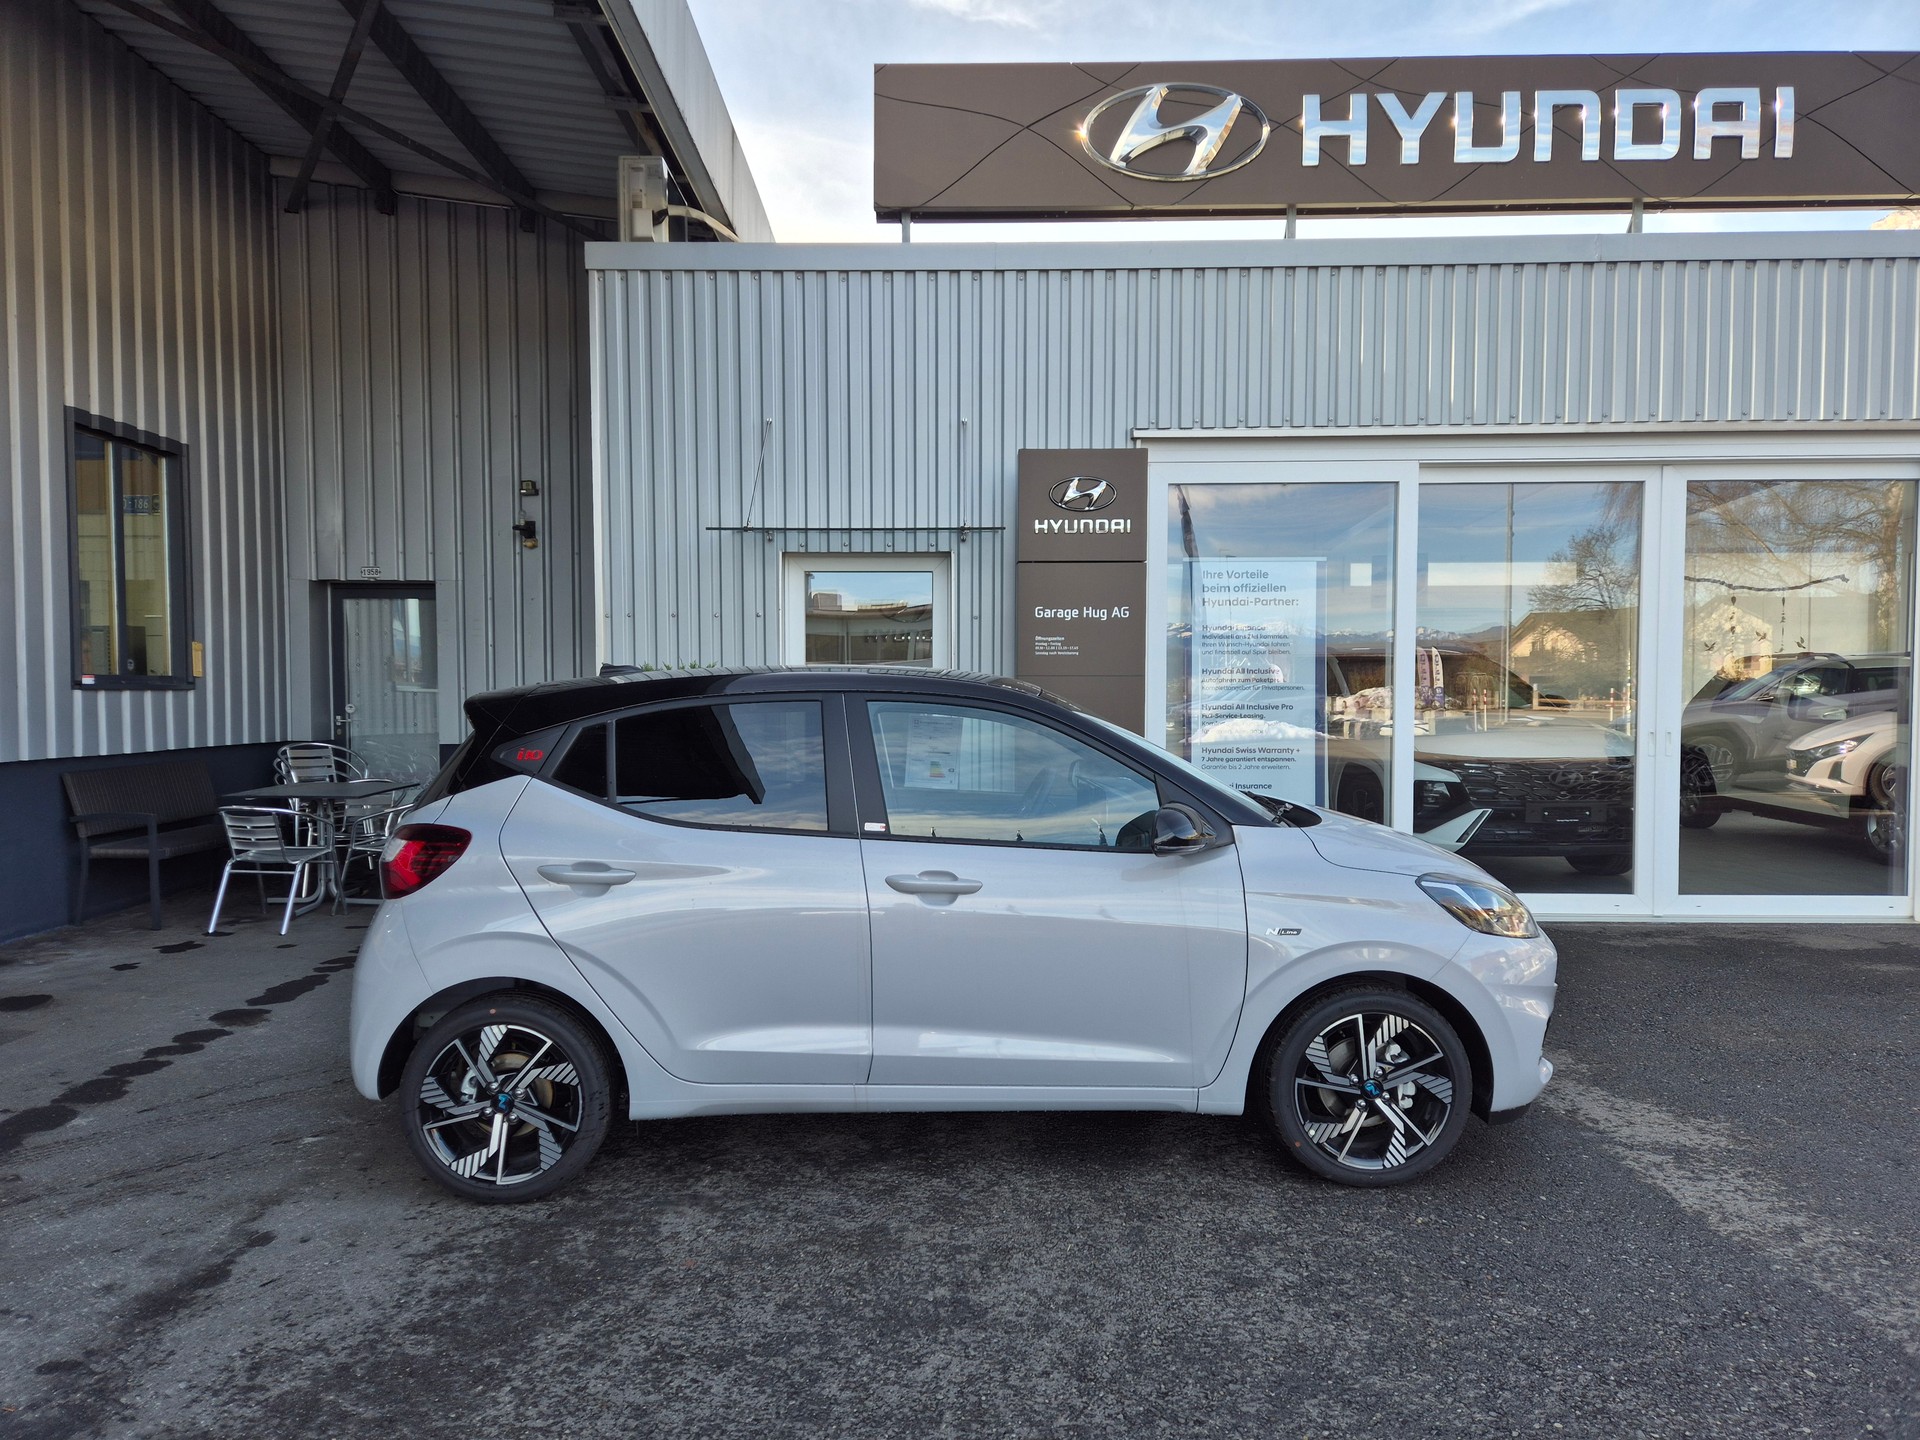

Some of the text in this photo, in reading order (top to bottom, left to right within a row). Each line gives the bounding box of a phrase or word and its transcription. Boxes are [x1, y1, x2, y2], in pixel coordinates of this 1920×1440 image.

[1301, 86, 1795, 167] HYUNDAI
[1034, 518, 1131, 534] HYUNDAI
[362, 568, 379, 576] 1958
[1202, 569, 1269, 579] Ihre Vorteile
[1202, 583, 1287, 593] beim offiziellen
[1202, 597, 1299, 608] Hyundai-Partner:
[1034, 606, 1130, 621] Garage Hug AG
[1258, 747, 1294, 755] Warranty
